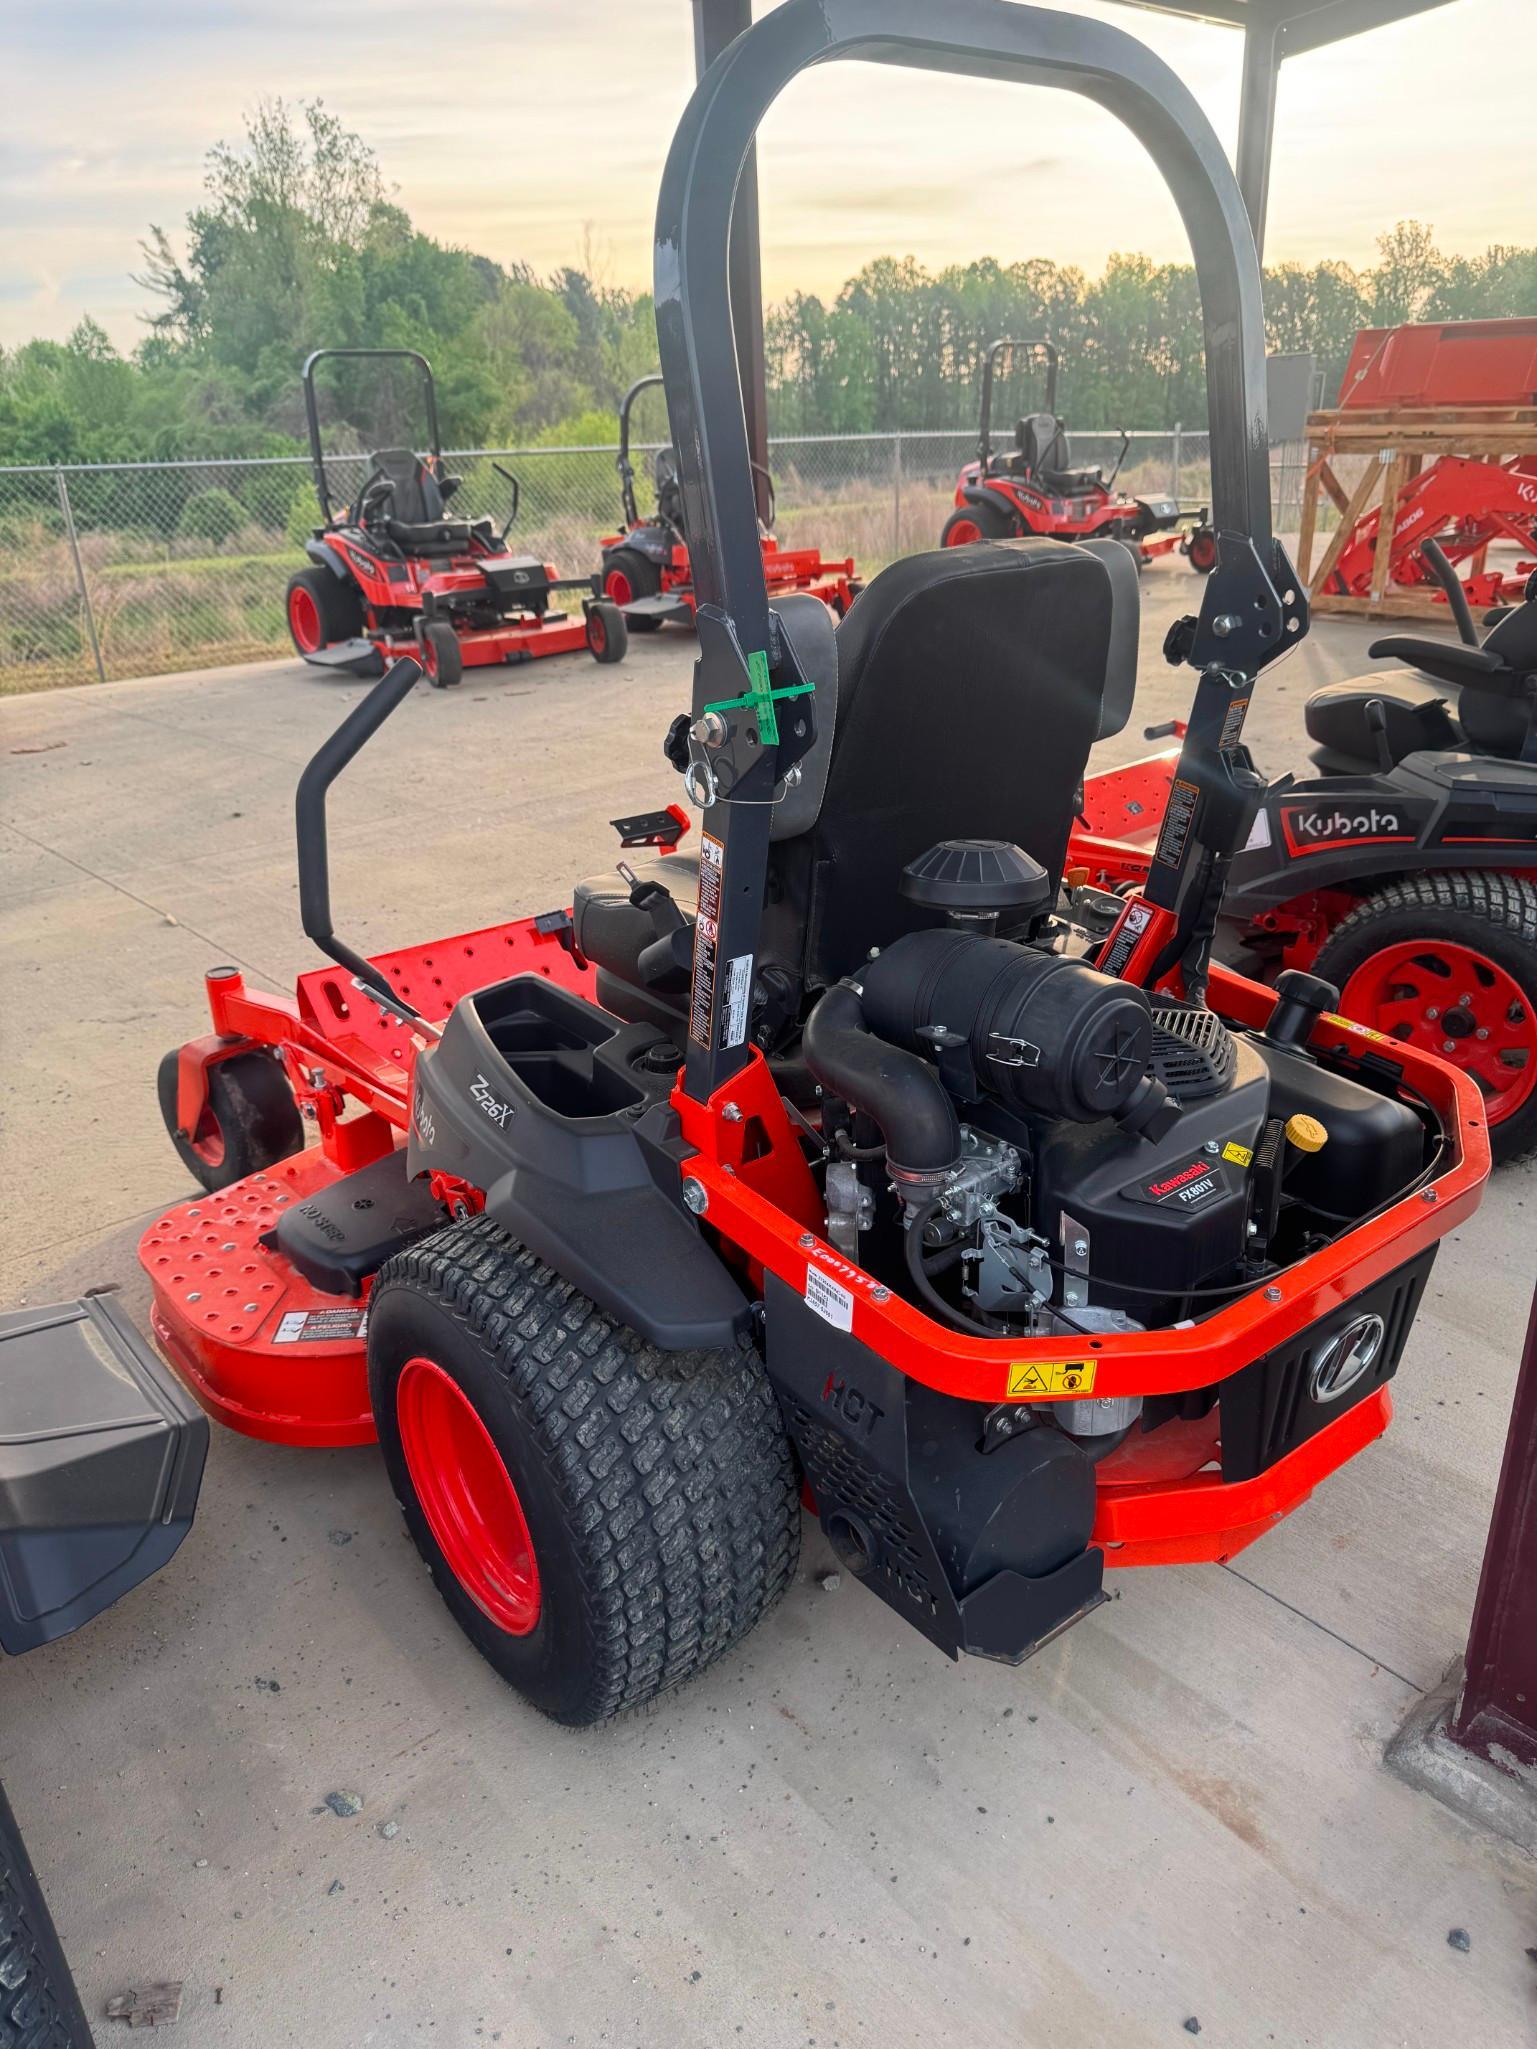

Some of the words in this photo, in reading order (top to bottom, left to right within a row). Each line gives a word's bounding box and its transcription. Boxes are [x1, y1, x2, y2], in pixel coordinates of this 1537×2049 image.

[1298, 809, 1399, 837] Kubota
[469, 1073, 515, 1128] Z726X
[1148, 1161, 1211, 1196] Kawasaki
[1179, 1178, 1214, 1202] FX801V
